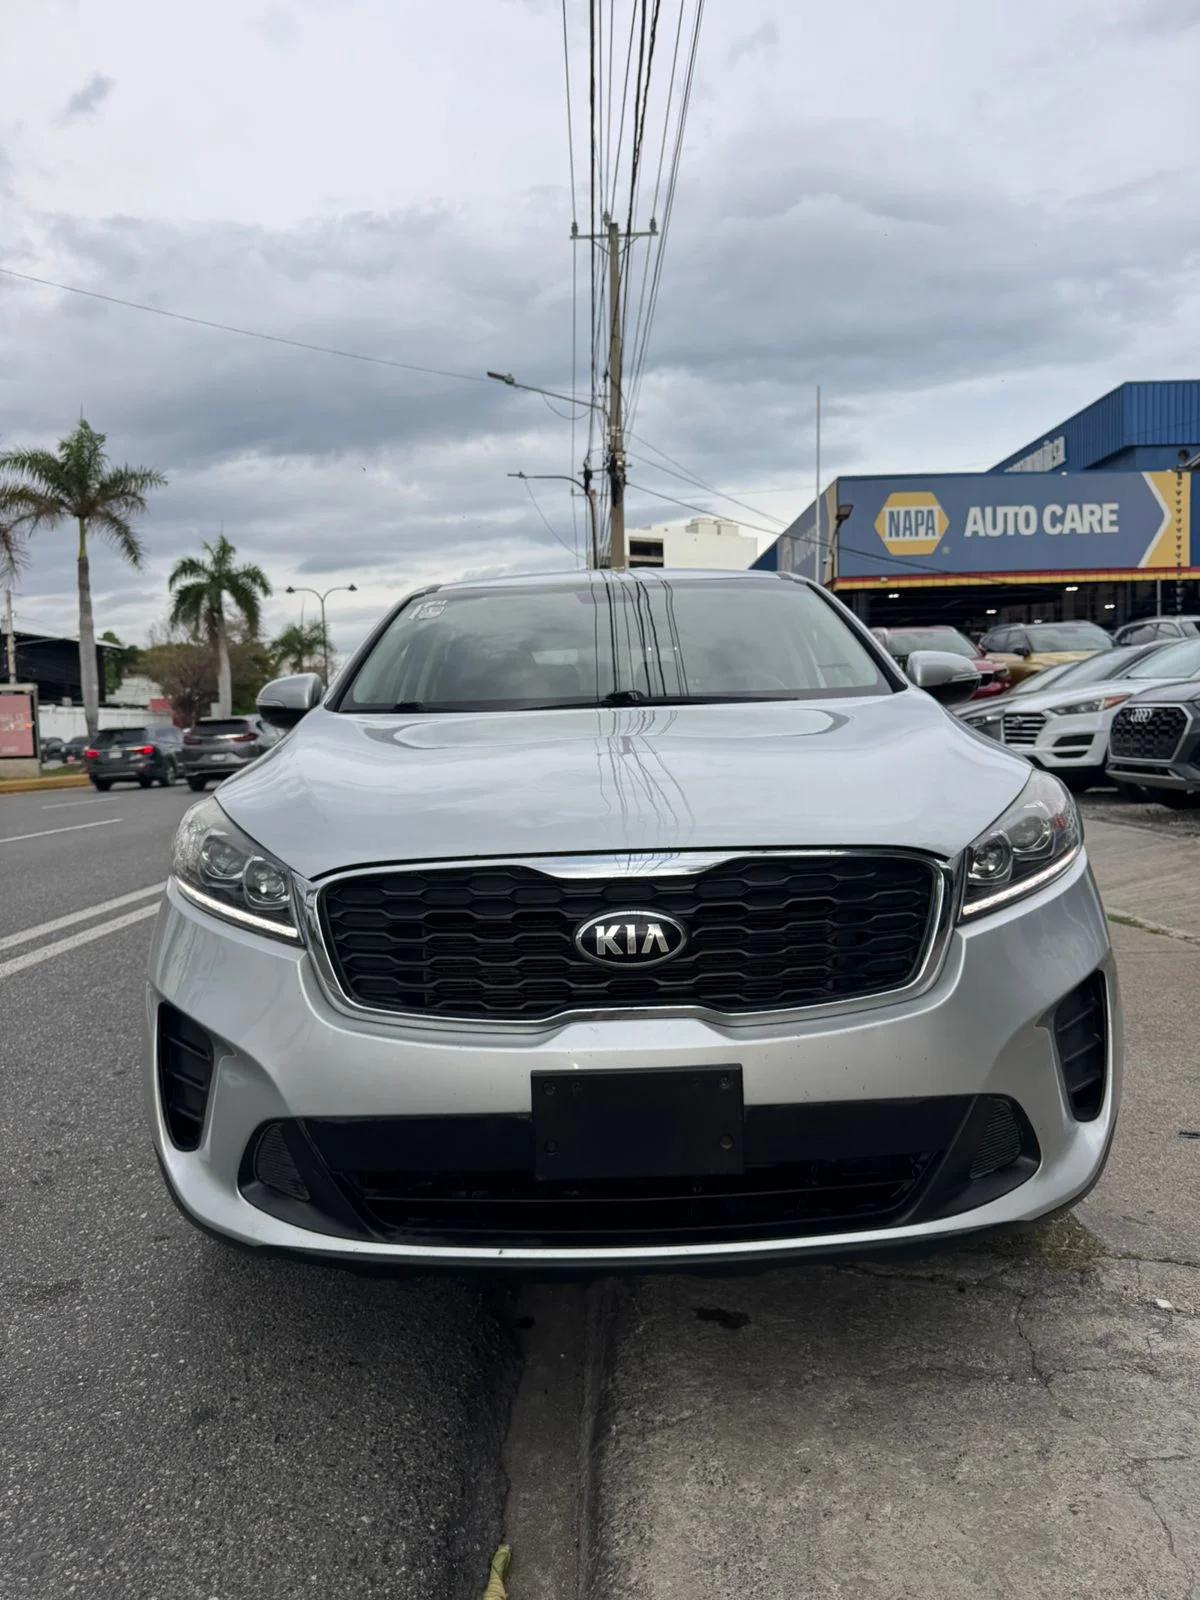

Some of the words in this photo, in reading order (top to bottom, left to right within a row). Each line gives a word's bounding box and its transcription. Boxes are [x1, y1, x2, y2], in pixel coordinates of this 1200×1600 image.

[888, 510, 936, 538] NAPA
[964, 505, 1037, 537] AUTO
[1043, 503, 1119, 535] CARE
[595, 924, 669, 955] KIA
